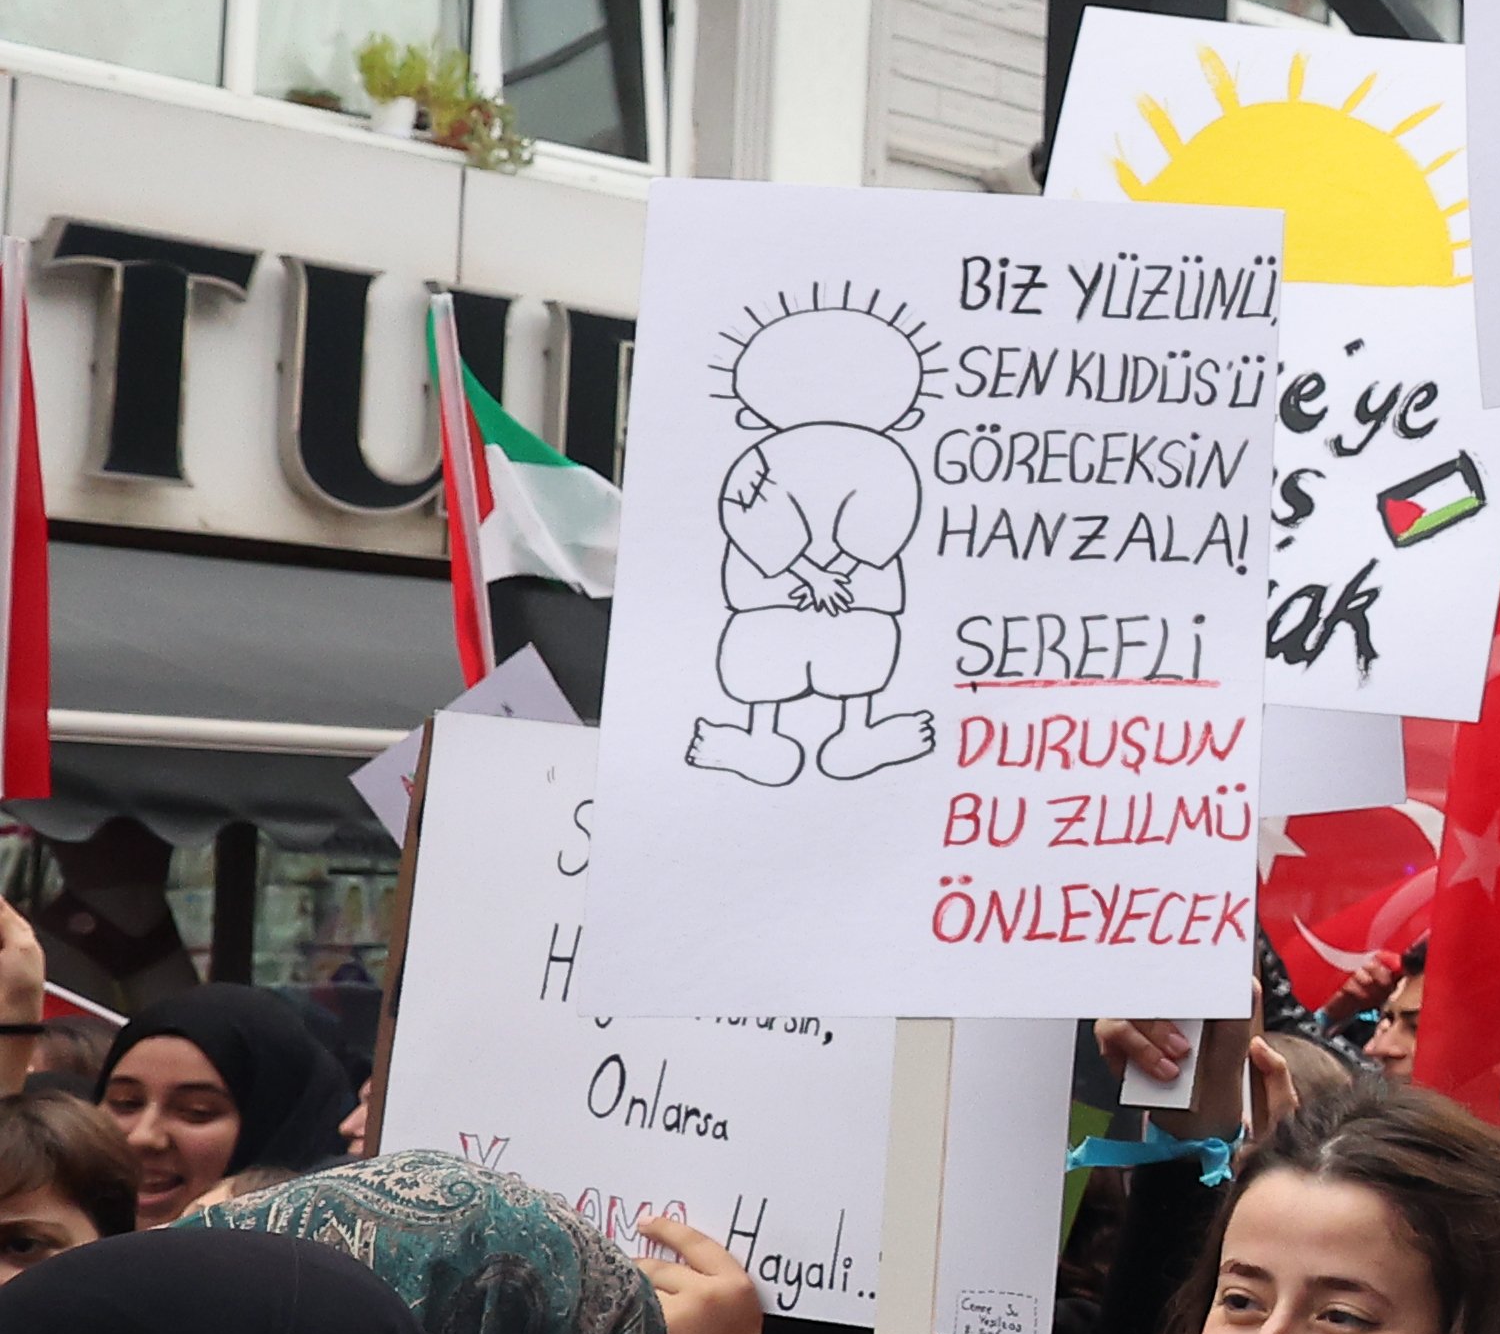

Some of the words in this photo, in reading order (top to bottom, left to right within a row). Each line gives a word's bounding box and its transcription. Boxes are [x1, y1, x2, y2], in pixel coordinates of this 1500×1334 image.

[959, 255, 1048, 315] BİZ
[955, 346, 1061, 398] SEN
[1066, 351, 1266, 408] KUDÜS'Ü
[934, 424, 1249, 489] GÖRECEKSİN
[937, 504, 1249, 575] HANZALA!
[958, 716, 1245, 775] DURUŞUN
[943, 793, 1027, 847] BU
[1048, 785, 1251, 846] ZULMÜ
[932, 876, 1250, 946] ÖNLEYECEK
[587, 1054, 729, 1140] Onlarsa
